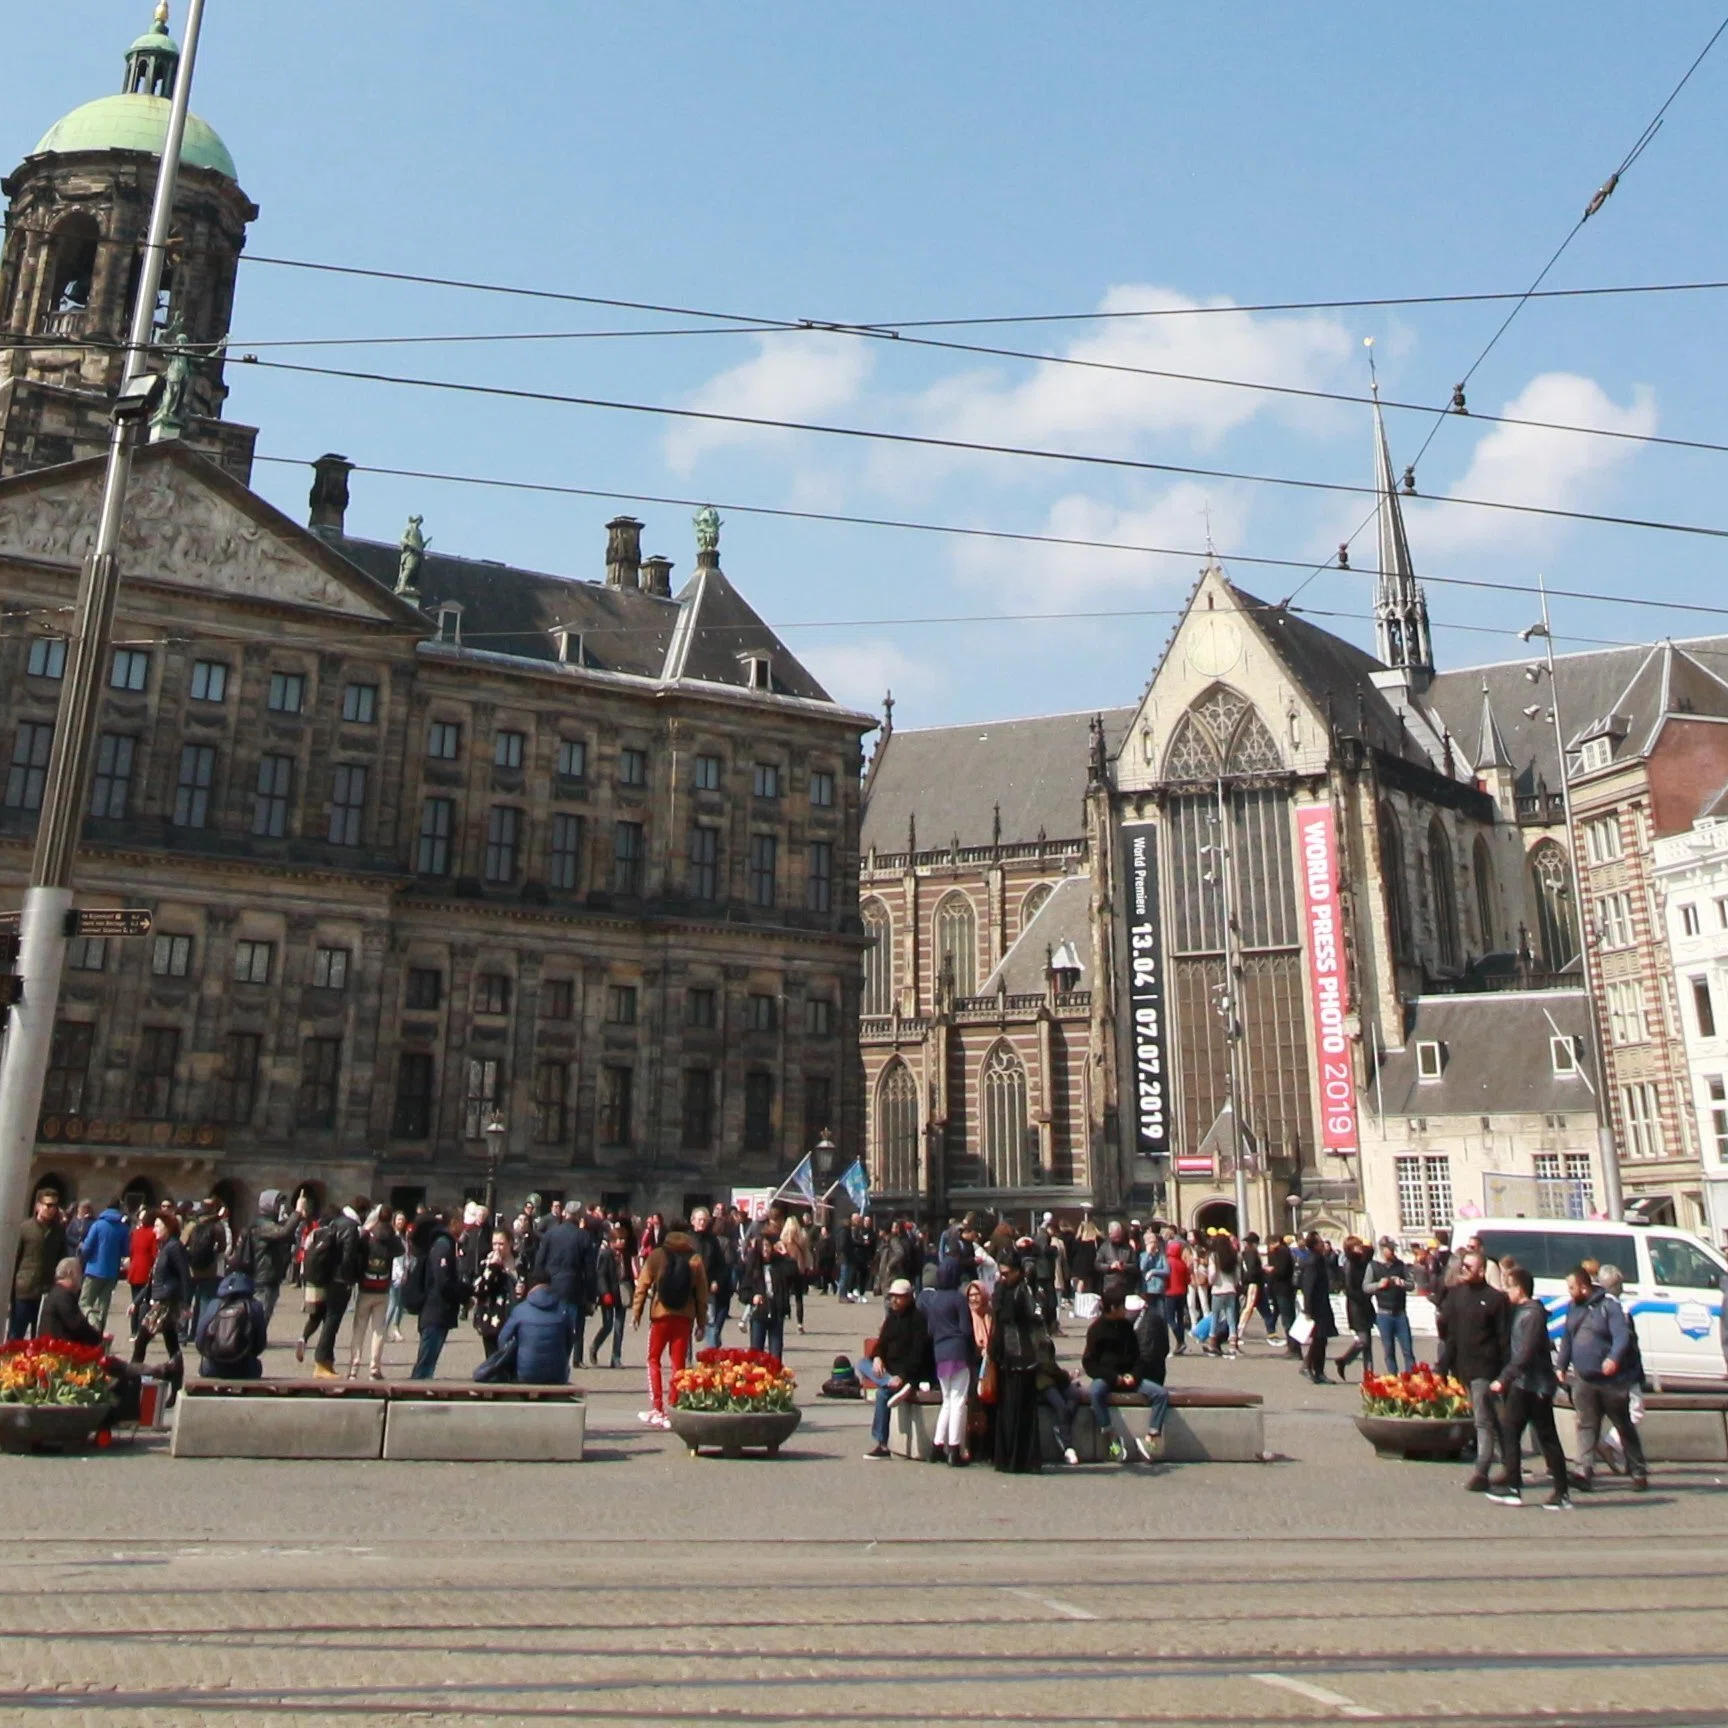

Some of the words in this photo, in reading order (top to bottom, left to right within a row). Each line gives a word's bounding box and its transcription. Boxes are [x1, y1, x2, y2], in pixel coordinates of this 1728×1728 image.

[1133, 836, 1146, 868] World
[1304, 821, 1330, 901] WORLD
[1134, 870, 1147, 915] Premiere
[1132, 922, 1155, 988] 13.04
[1311, 904, 1338, 973] PRESS
[1318, 976, 1345, 1054] PHOTO
[1135, 1008, 1164, 1140] 07.07.2019
[1324, 1063, 1353, 1135] 2019
